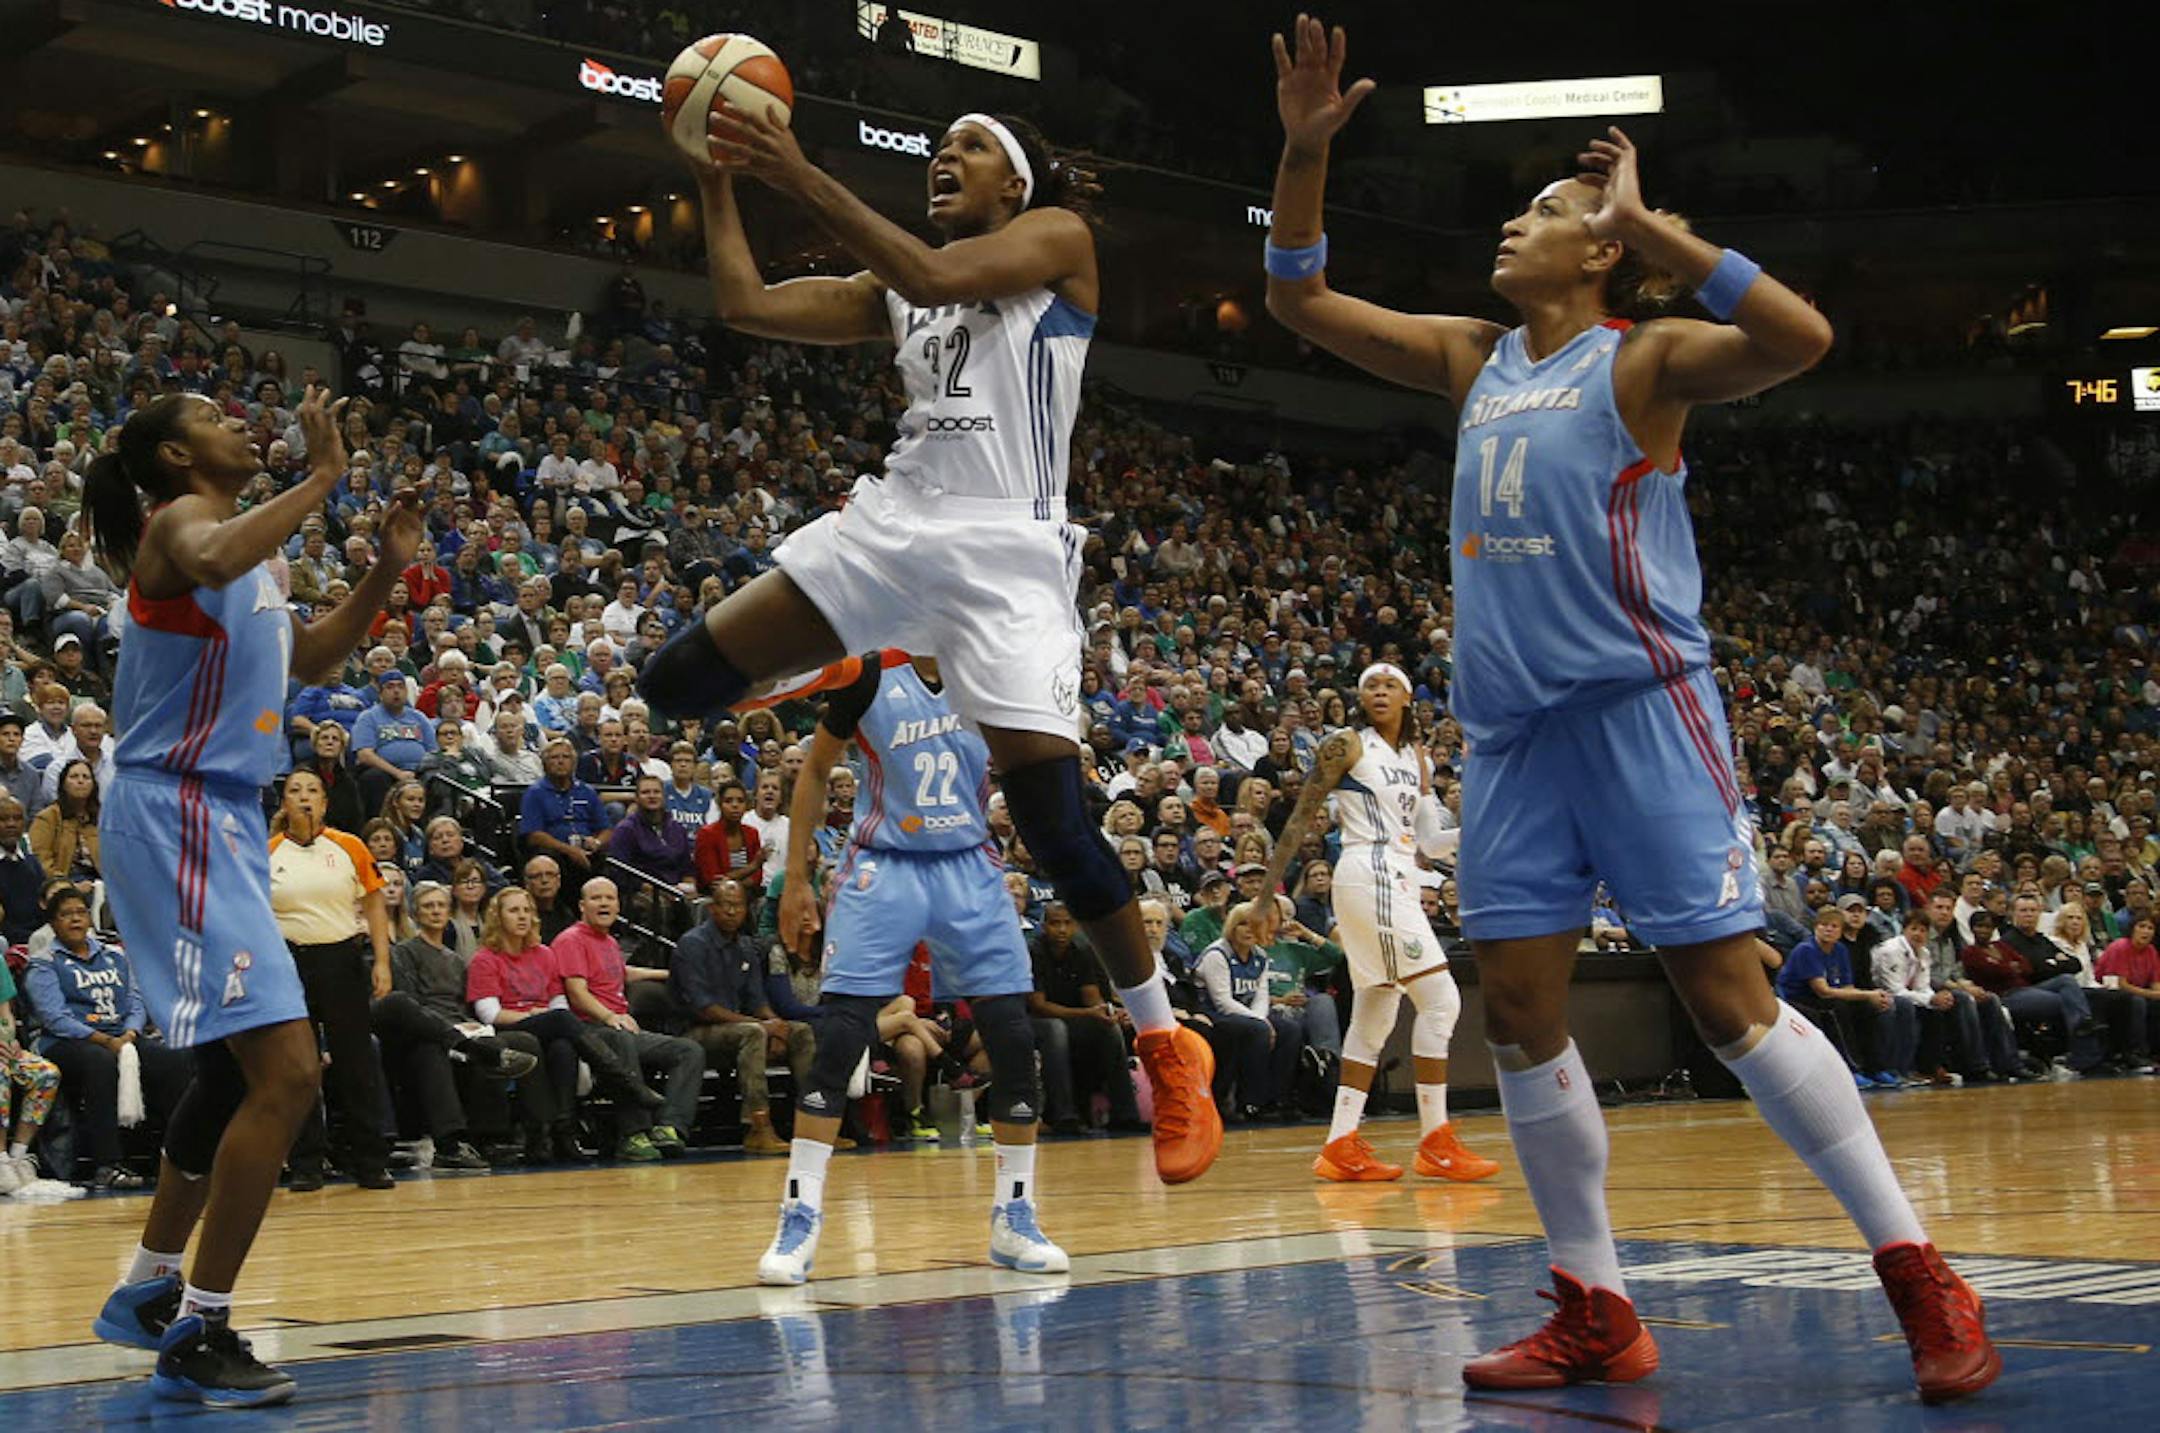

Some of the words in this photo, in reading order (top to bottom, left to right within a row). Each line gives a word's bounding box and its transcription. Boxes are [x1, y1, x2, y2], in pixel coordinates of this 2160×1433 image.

[174, 0, 272, 24] oost
[279, 5, 384, 46] mobile
[580, 62, 663, 102] boost
[1565, 91, 1609, 104] Medical
[1613, 90, 1649, 102] Center
[859, 120, 931, 157] boost
[350, 227, 381, 248] 112
[1461, 388, 1581, 430] ATLANTA
[2066, 379, 2117, 404] 7:46
[927, 411, 995, 432] boost
[1480, 435, 1528, 518] 14
[1484, 532, 1555, 556] boost
[889, 713, 962, 749] ATLAN
[914, 751, 958, 806] 22
